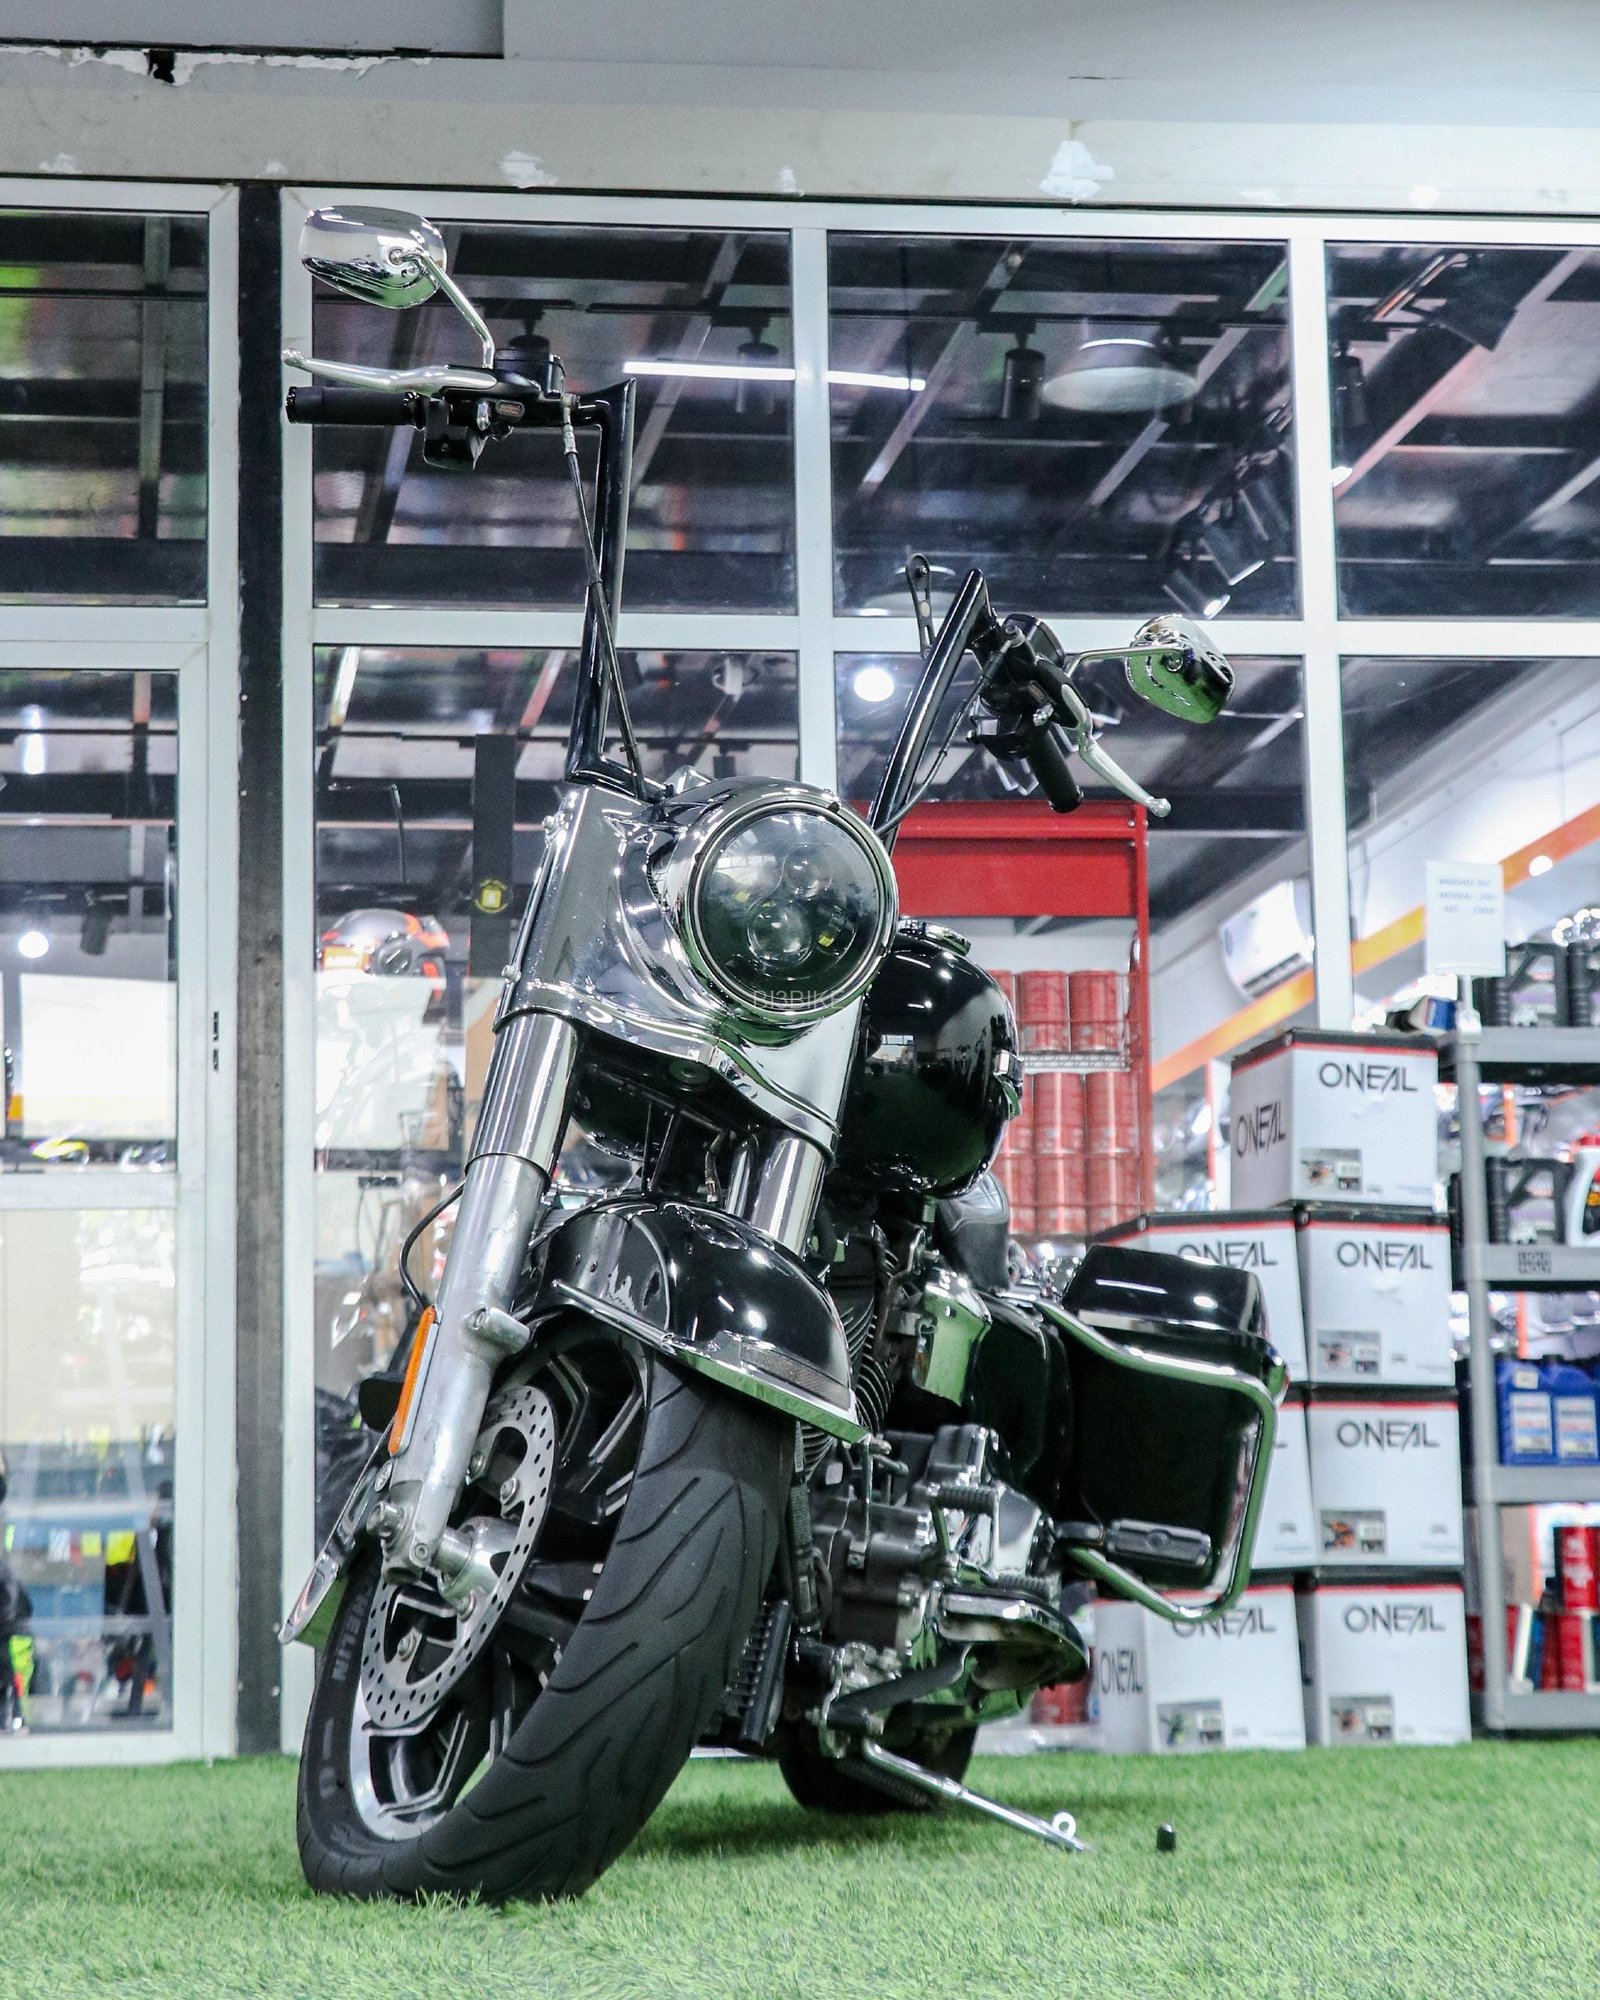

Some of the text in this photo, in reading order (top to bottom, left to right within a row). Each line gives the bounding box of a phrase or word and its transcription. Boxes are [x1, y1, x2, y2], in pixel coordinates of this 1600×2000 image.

[1319, 1062, 1419, 1094] ONEAL
[1337, 1241, 1434, 1273] ONEAL
[1337, 1420, 1440, 1452] ONEAL
[1344, 1604, 1447, 1636] ONEAL
